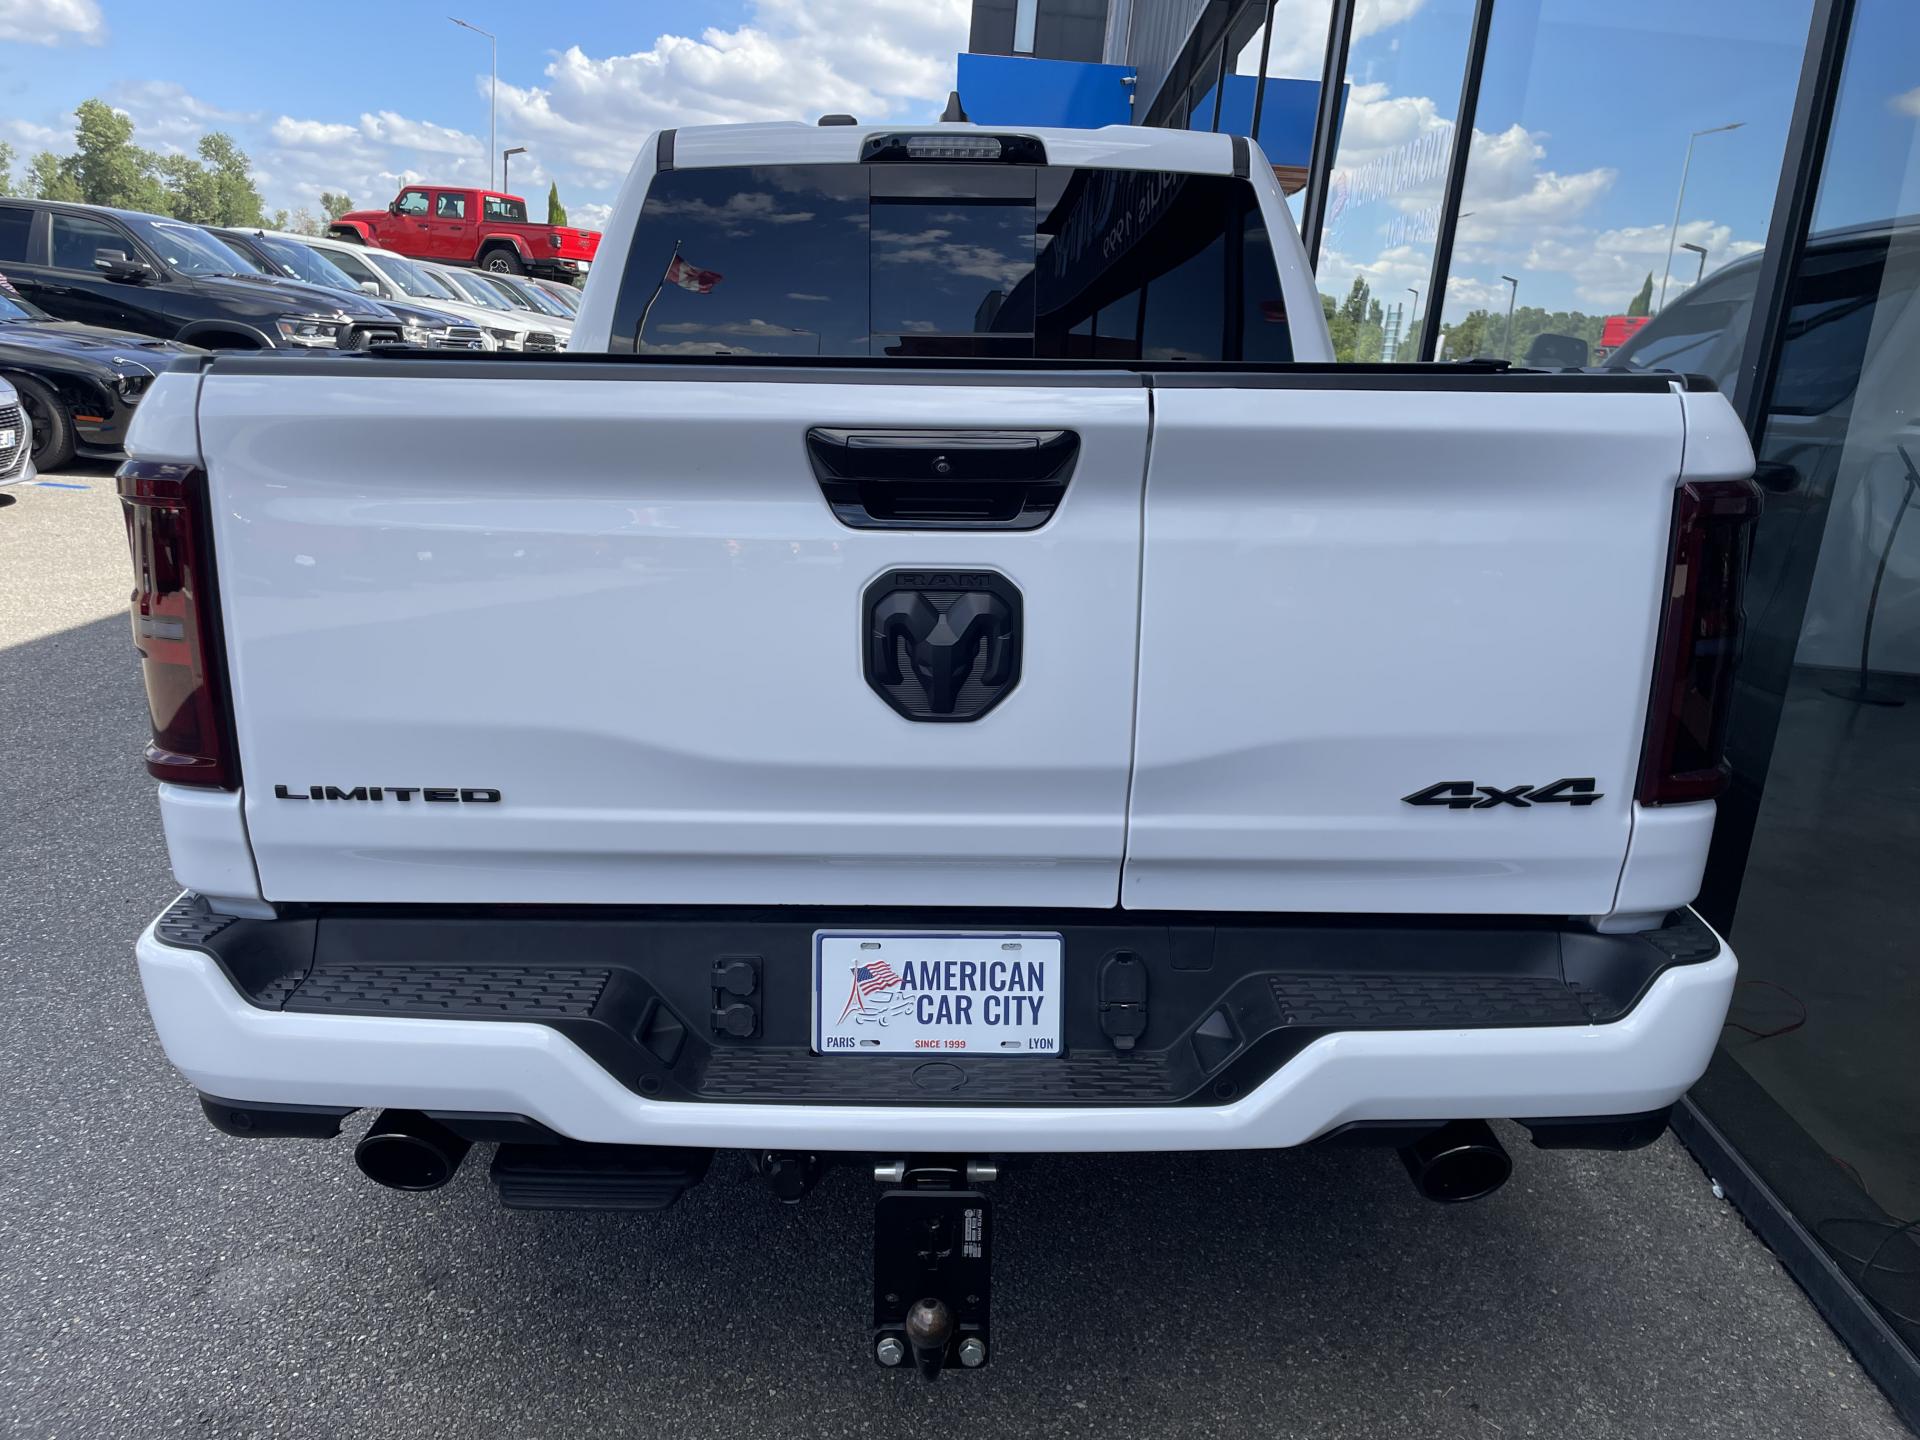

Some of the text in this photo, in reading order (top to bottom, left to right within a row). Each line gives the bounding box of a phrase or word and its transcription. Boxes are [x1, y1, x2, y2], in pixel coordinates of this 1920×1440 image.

[896, 573, 990, 586] RAM
[274, 784, 501, 802] LIMITED
[900, 960, 1044, 991] AMERICAN
[916, 995, 1044, 1025] CAR CITY
[826, 1036, 855, 1048] PARIS
[914, 1039, 966, 1049] SINCE 1999
[1028, 1037, 1054, 1049] LYON
